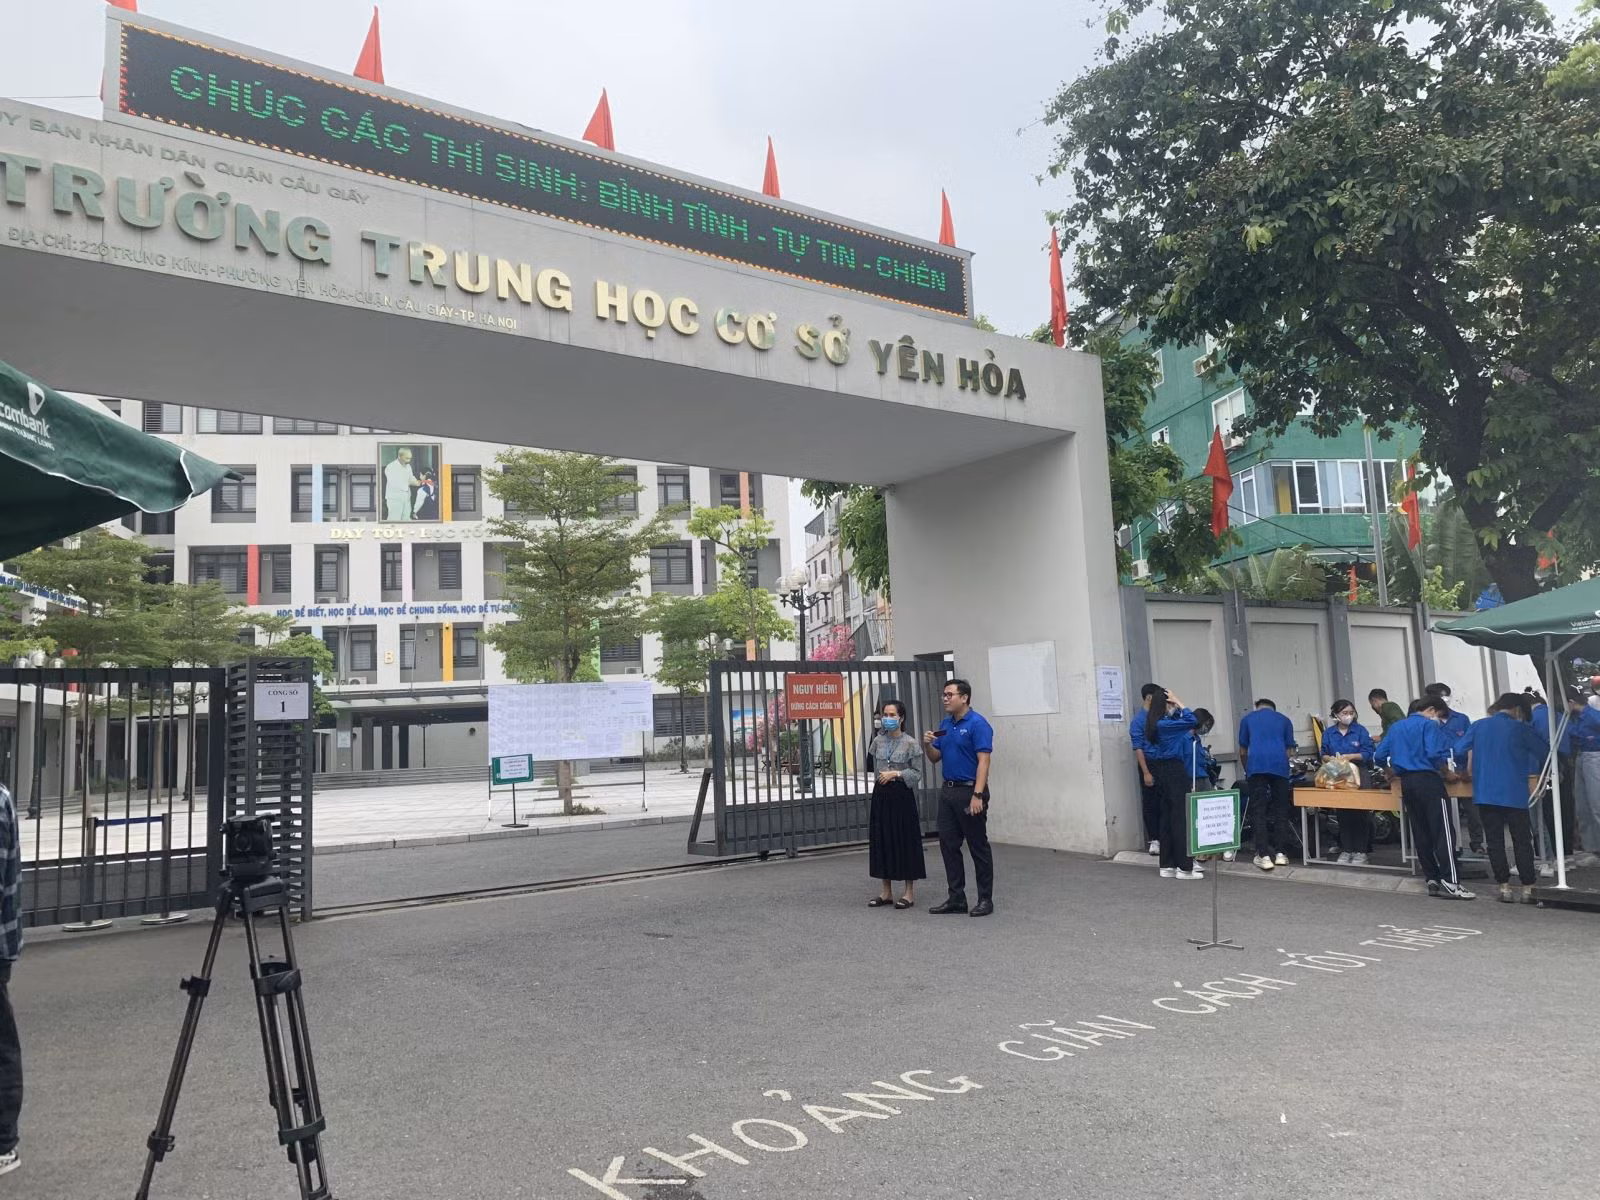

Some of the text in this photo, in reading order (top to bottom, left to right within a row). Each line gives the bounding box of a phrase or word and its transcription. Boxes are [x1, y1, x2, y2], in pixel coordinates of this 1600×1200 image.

[0, 110, 21, 127] Y
[30, 118, 82, 141] BAN
[89, 131, 153, 158] NHÂN
[160, 147, 207, 169] DÂN
[214, 160, 273, 184] QUẬN
[171, 66, 306, 127] CHÚC
[320, 107, 411, 155] CÁC
[423, 132, 485, 176] THÍ
[495, 153, 588, 202] SINH:
[600, 178, 674, 224] BÌNH
[682, 203, 749, 243] TĨNH
[772, 227, 811, 263] TỰ
[816, 239, 857, 271] TIN
[8, 226, 39, 246] ĐỊA
[0, 152, 1027, 401] TRƯỜNG TRUNG HỌC CƠ SỞ YÊN HÒA
[409, 605, 435, 615] CHUNG
[281, 701, 286, 713] 1
[792, 684, 814, 695] NGUY
[566, 1069, 984, 1200] KHOẢNG
[998, 1019, 1156, 1061] GIÃN
[1152, 973, 1297, 1014] CÁCH
[1276, 948, 1382, 973] TỐI
